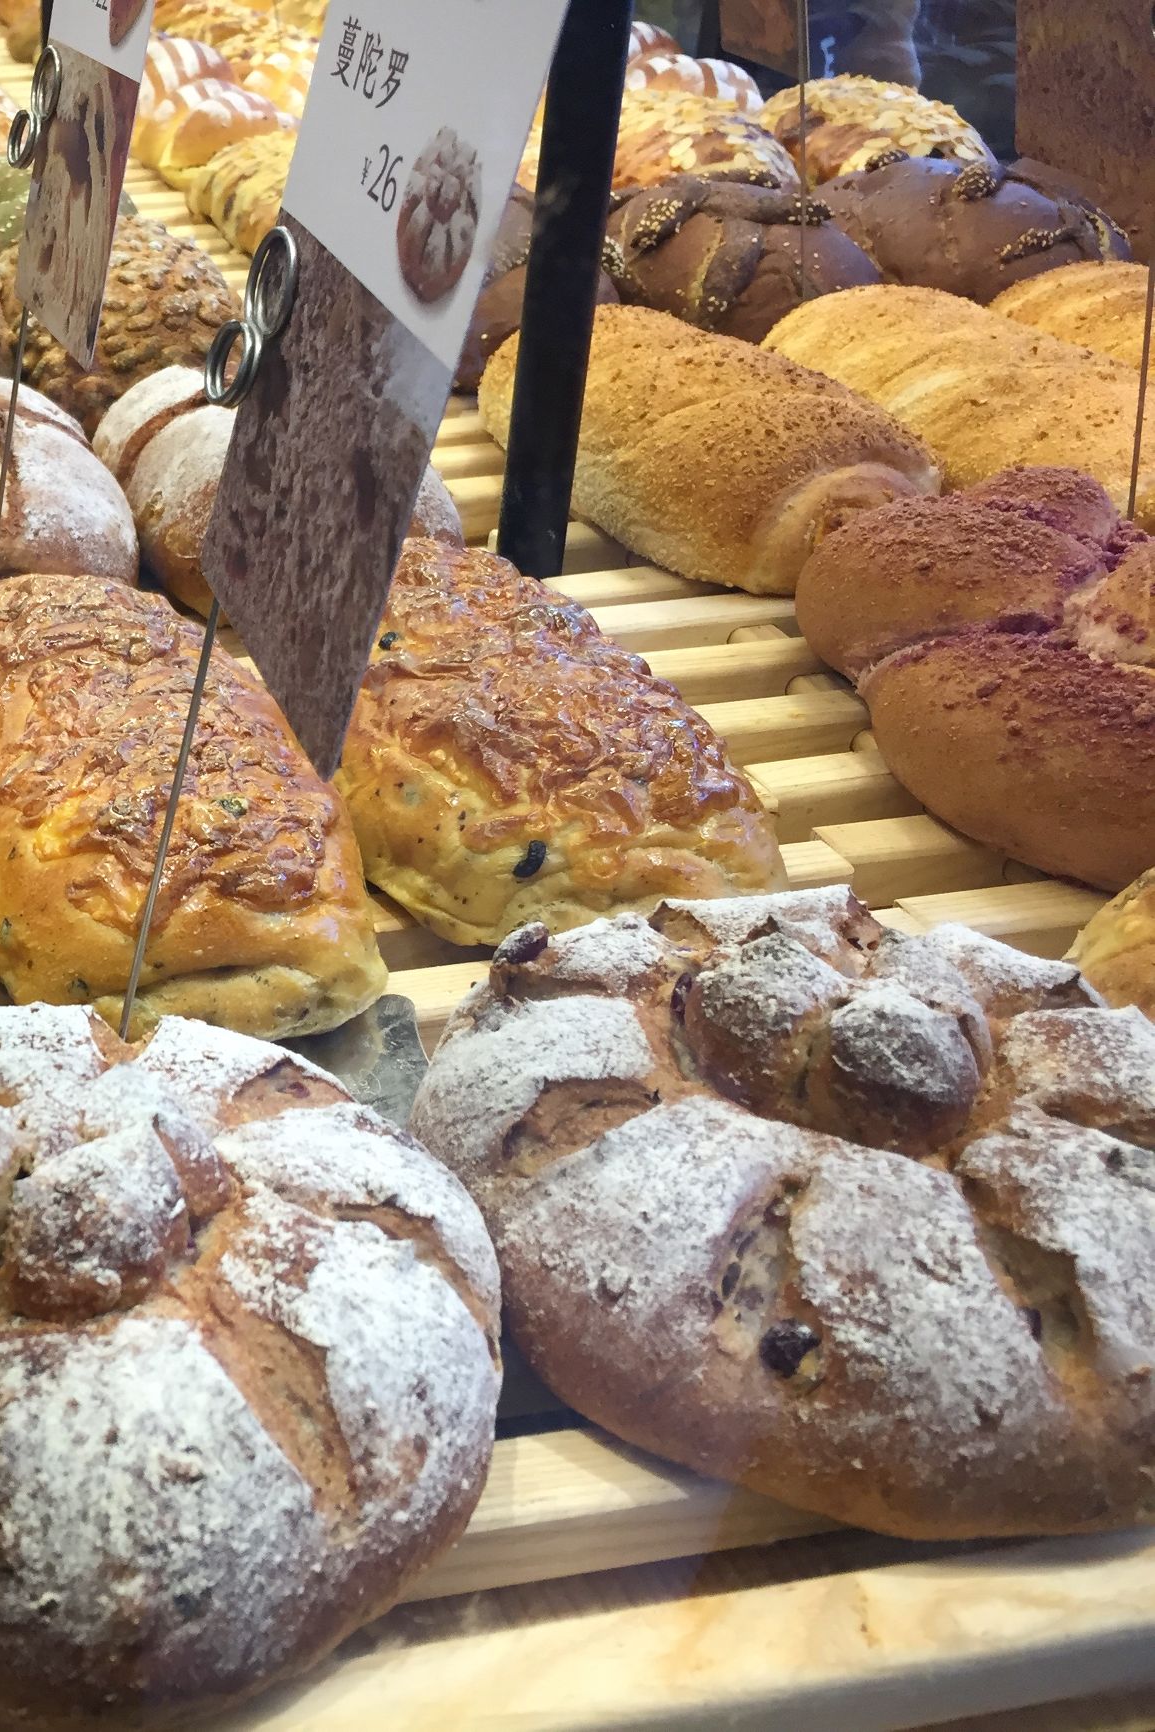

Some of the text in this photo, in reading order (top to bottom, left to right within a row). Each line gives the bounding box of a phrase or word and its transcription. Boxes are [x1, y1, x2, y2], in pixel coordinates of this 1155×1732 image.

[330, 15, 409, 108] 蔓陀罗
[361, 144, 403, 212] ¥26
